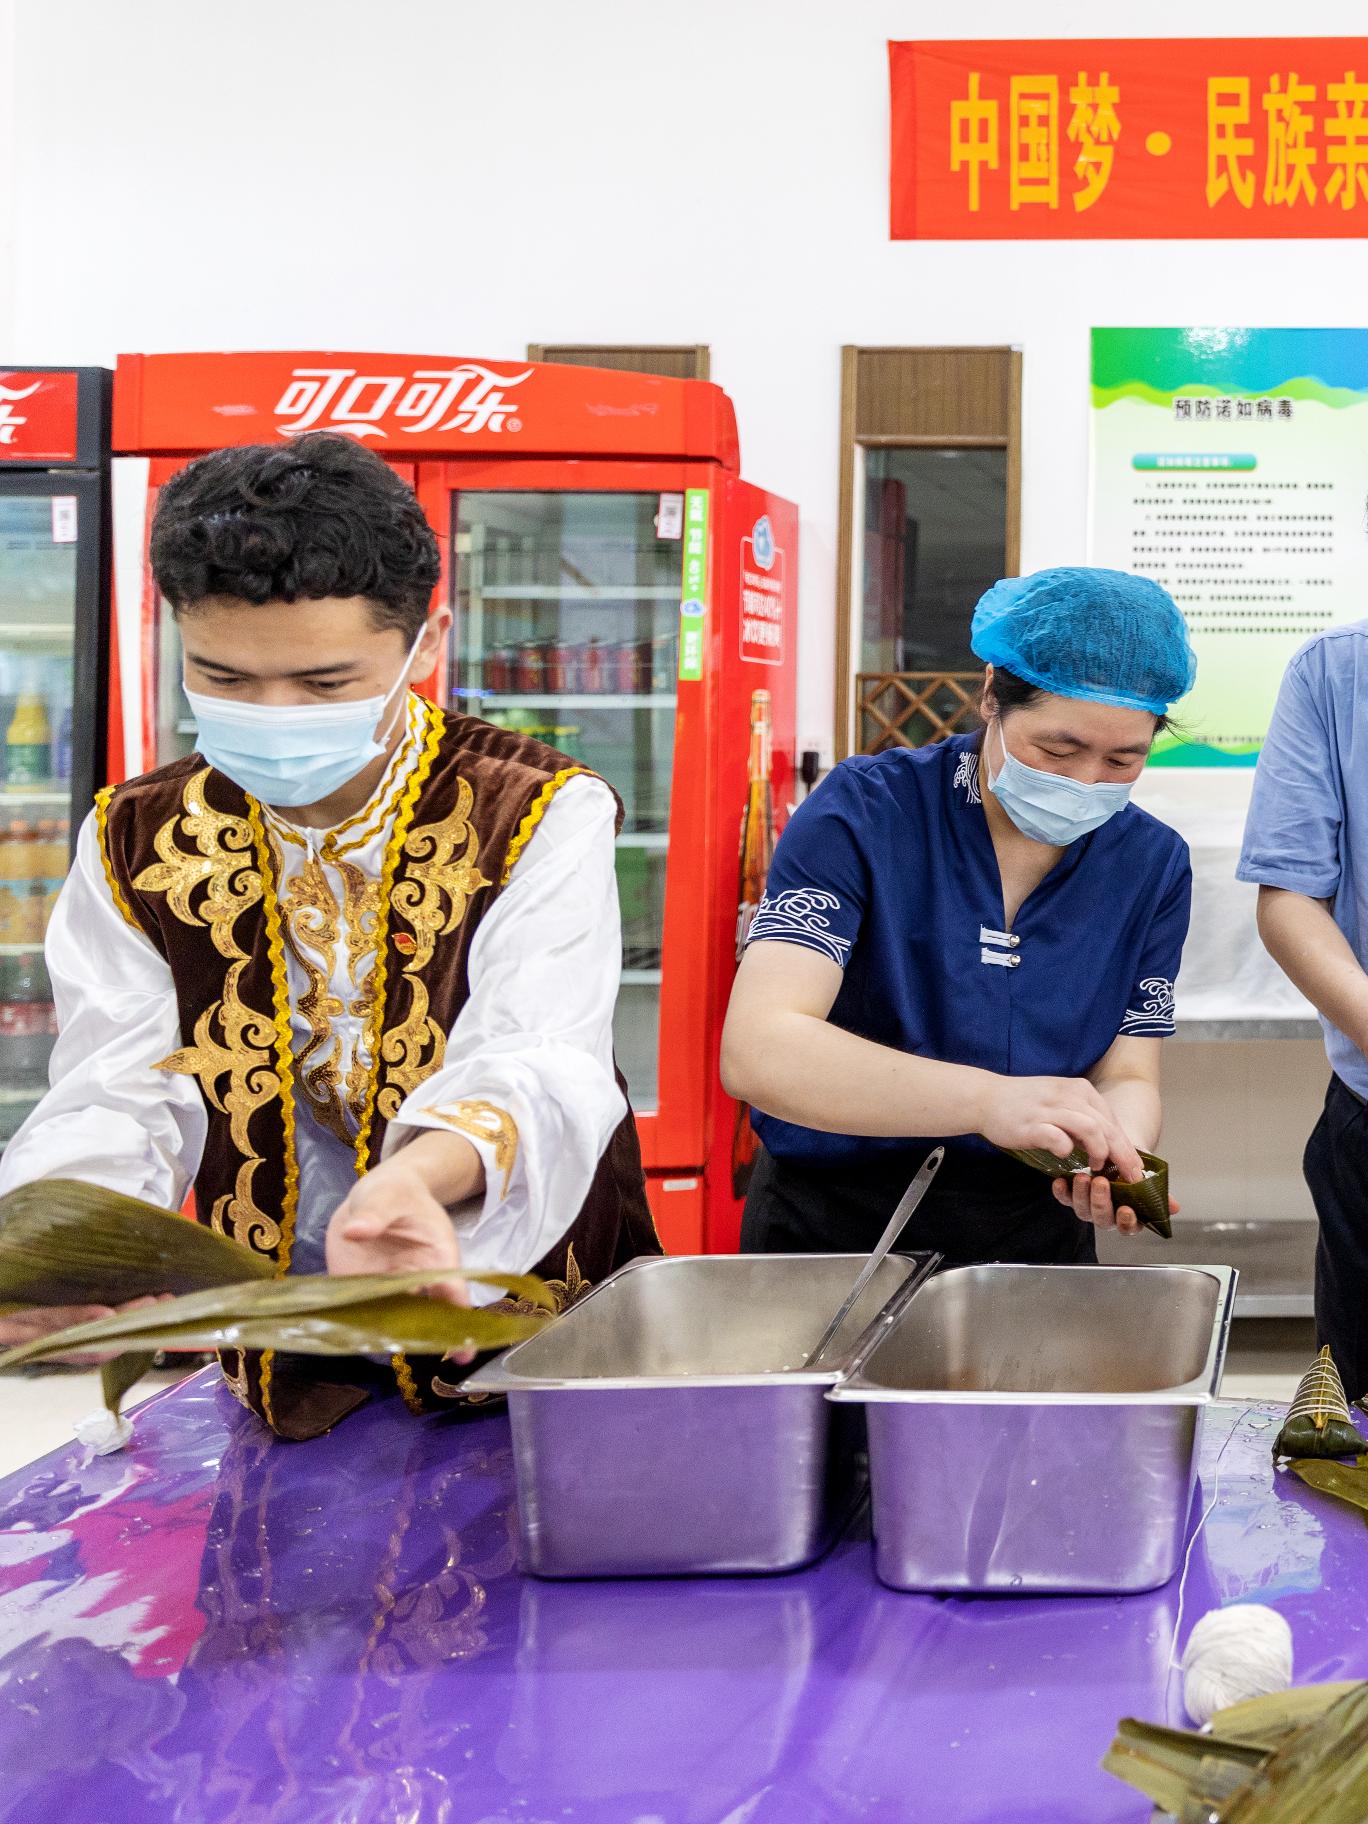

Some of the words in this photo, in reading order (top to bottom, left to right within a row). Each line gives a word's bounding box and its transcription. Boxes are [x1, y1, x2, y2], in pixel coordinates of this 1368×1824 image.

[273, 363, 535, 437] 可口可乐
[1174, 398, 1294, 419] 预防诺如病毒
